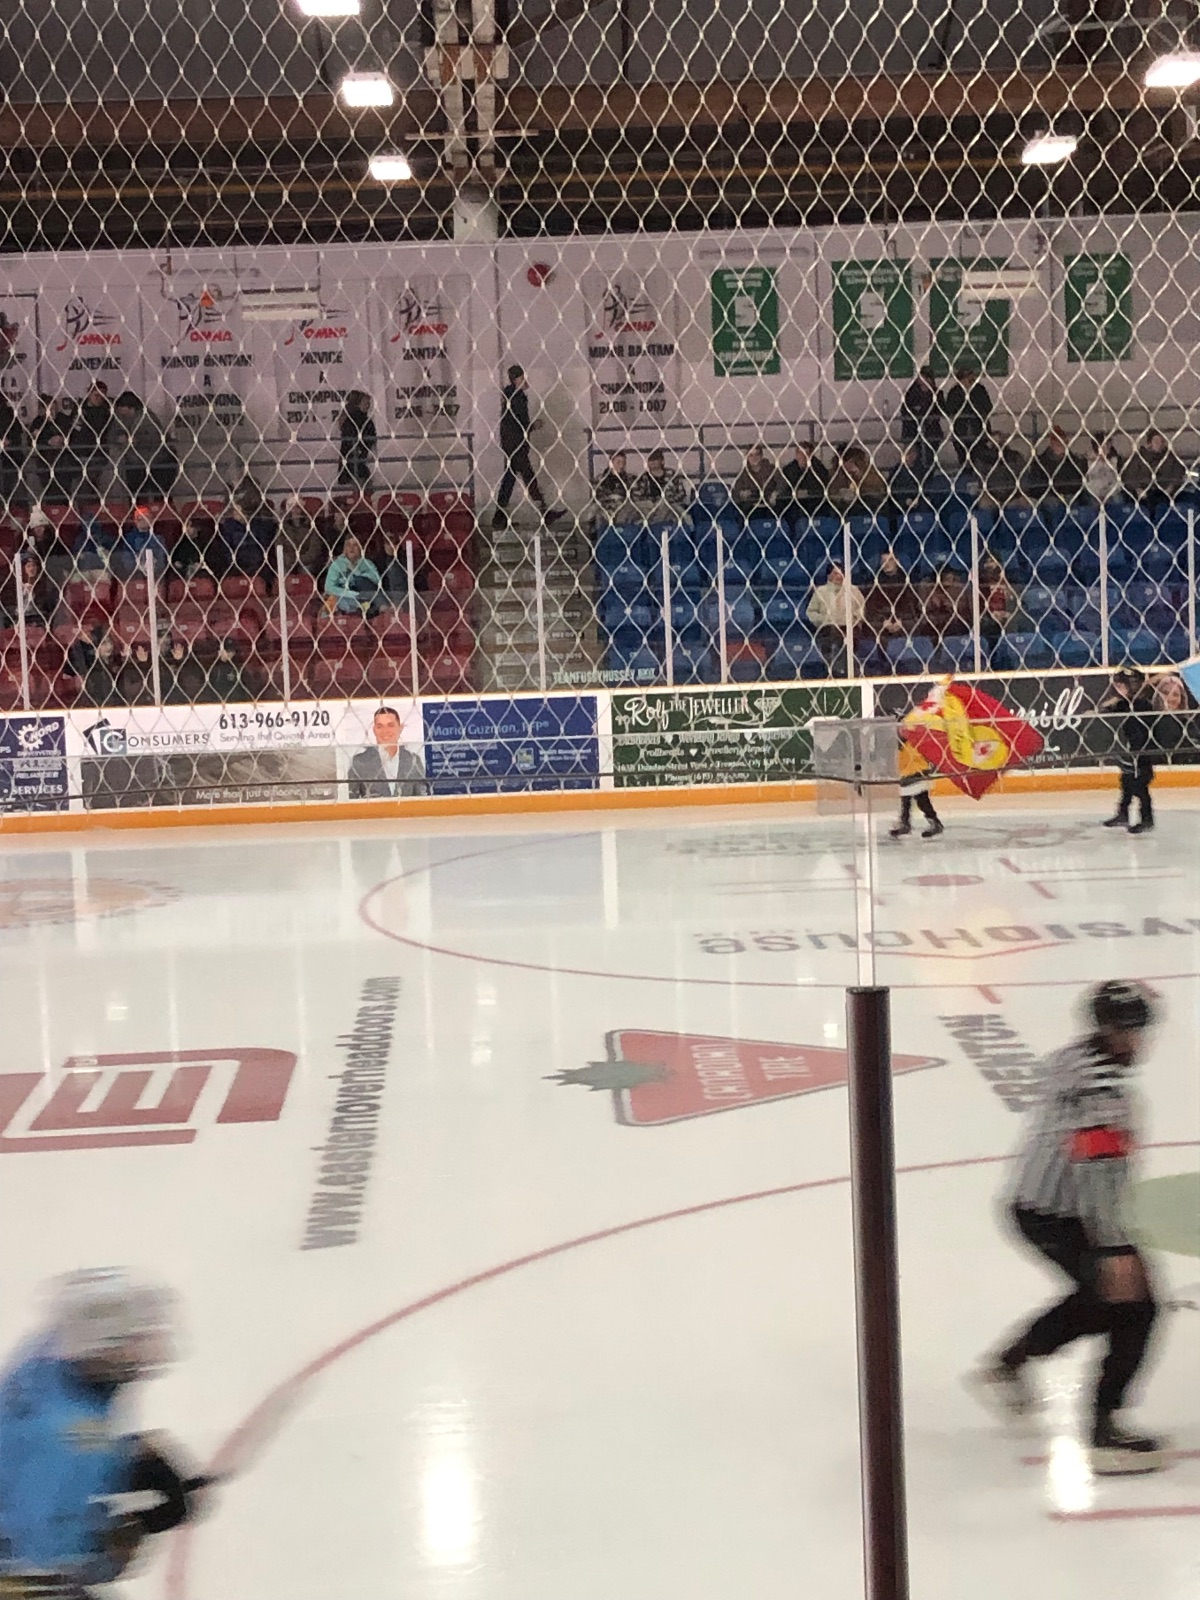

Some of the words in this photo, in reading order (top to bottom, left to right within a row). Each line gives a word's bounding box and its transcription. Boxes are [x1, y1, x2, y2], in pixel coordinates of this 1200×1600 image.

[301, 351, 343, 364] NOVICE
[203, 374, 211, 387] A
[219, 710, 330, 730] 613-966-9120
[12, 784, 63, 795] SERVICES
[690, 1042, 755, 1100] CANADIAN
[758, 1055, 813, 1082] TIRE
[298, 976, 402, 1251] www.easternoverheaddoors.com
